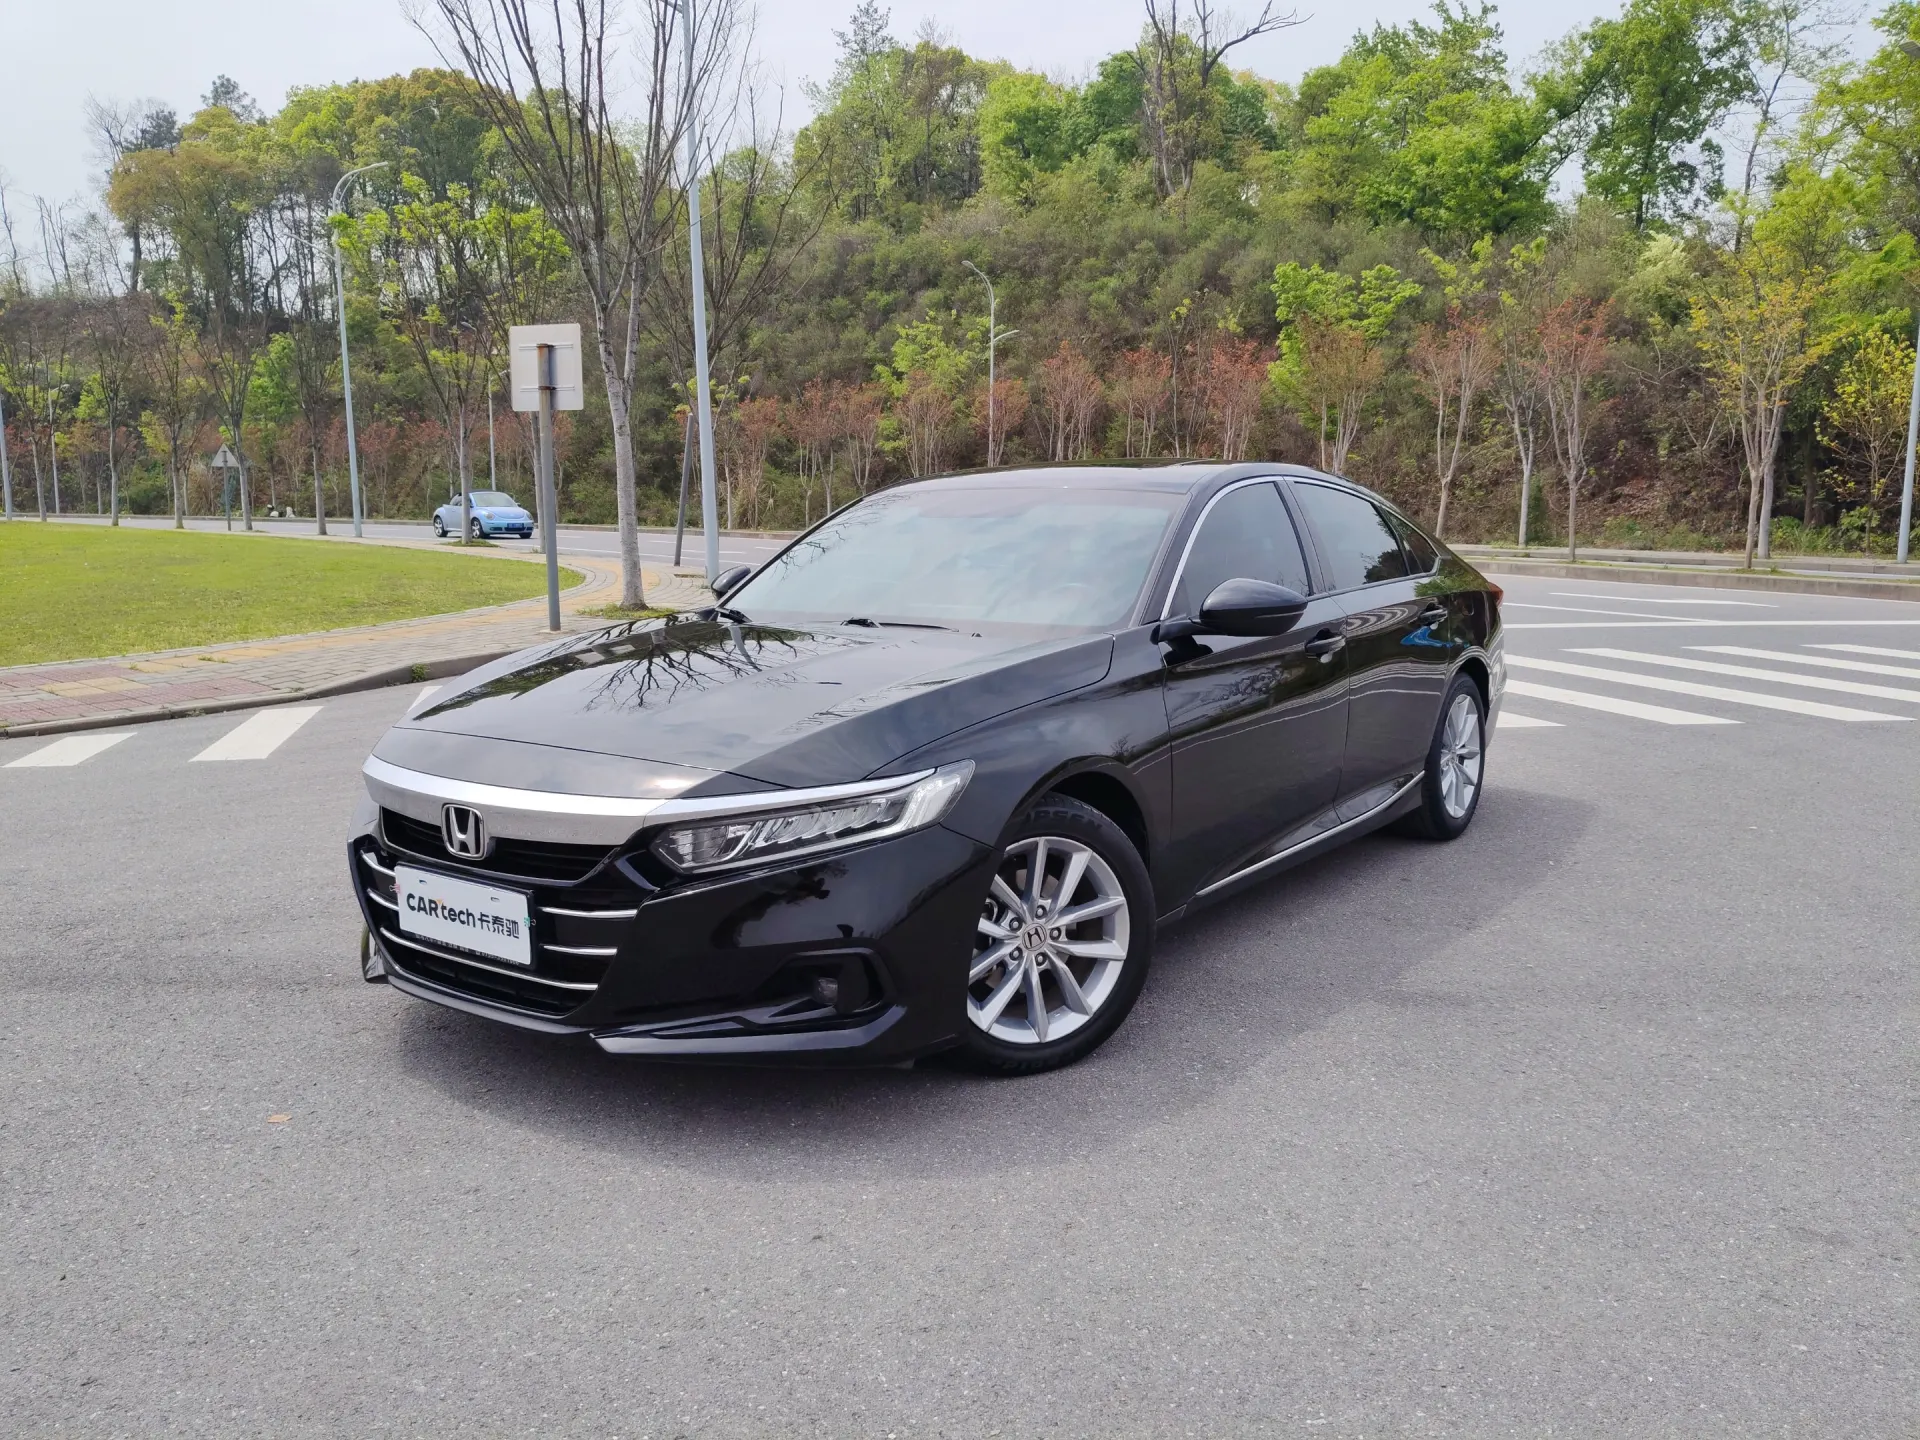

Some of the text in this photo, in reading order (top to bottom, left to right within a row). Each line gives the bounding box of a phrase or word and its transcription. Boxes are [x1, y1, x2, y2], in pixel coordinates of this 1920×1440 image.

[449, 806, 476, 855] H
[406, 893, 520, 939] CARtech 卡泰驰
